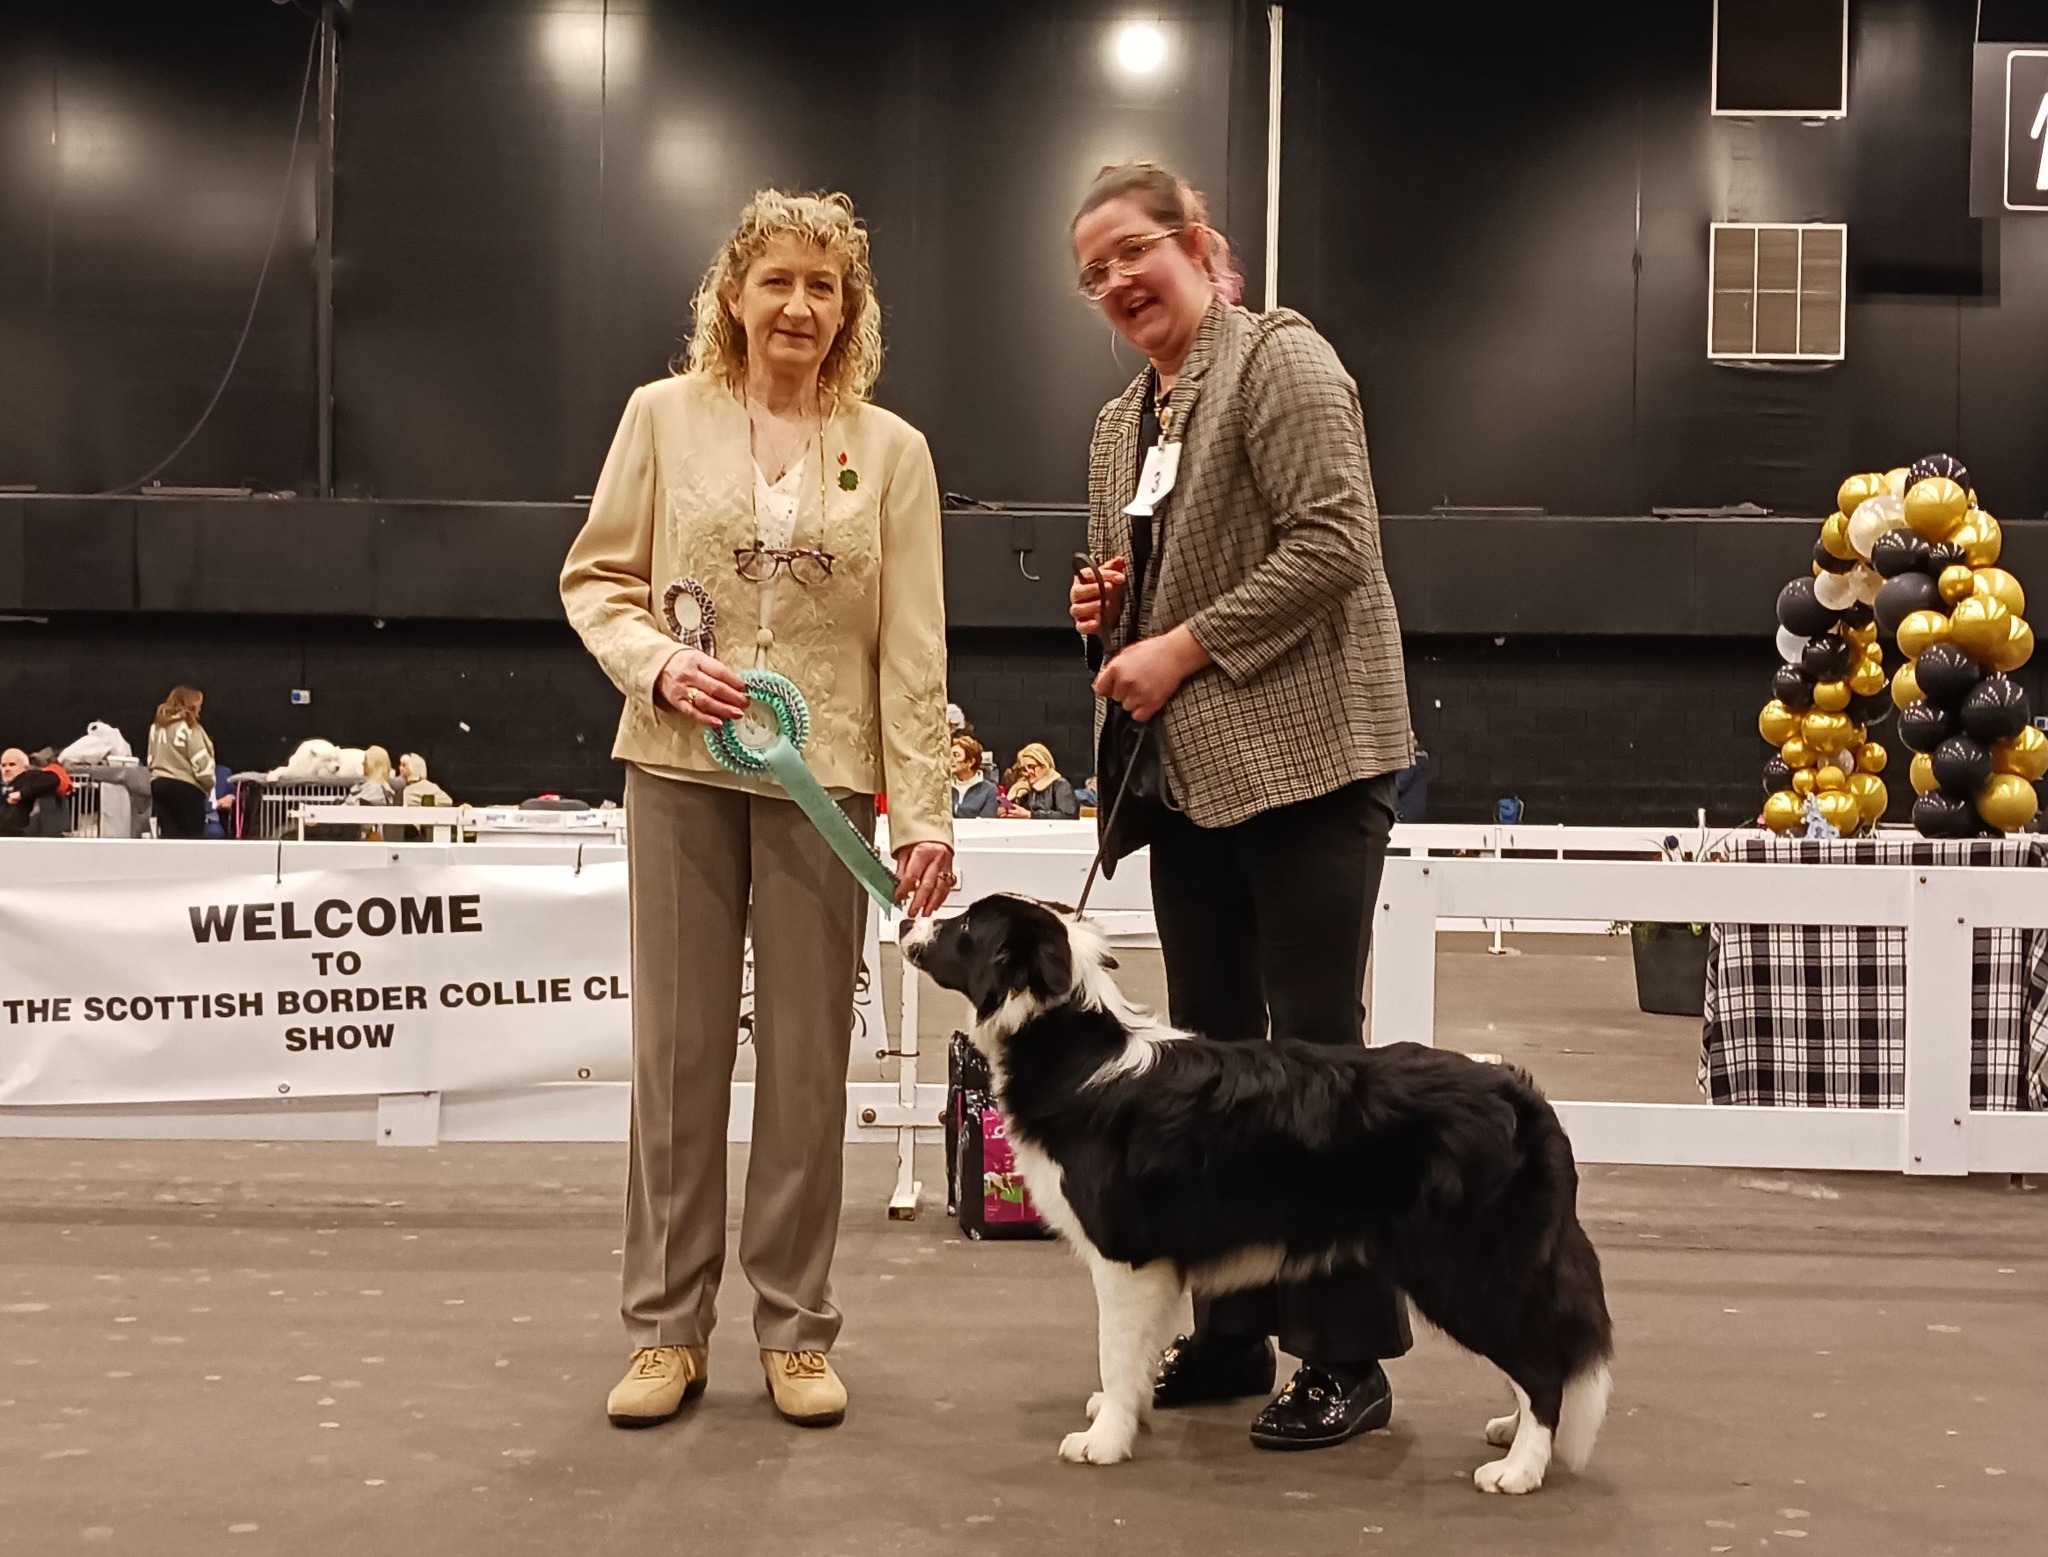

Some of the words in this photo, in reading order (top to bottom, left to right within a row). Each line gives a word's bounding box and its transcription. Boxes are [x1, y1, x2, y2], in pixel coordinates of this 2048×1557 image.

[190, 895, 483, 943] WELCOME
[312, 951, 361, 975] TO
[3, 998, 72, 1024] THE
[84, 992, 262, 1021] SCOTTISH
[278, 986, 427, 1014] BORDER
[440, 978, 572, 1008] COLLIE
[583, 976, 629, 1001] CL
[286, 1024, 395, 1051] SHOW
